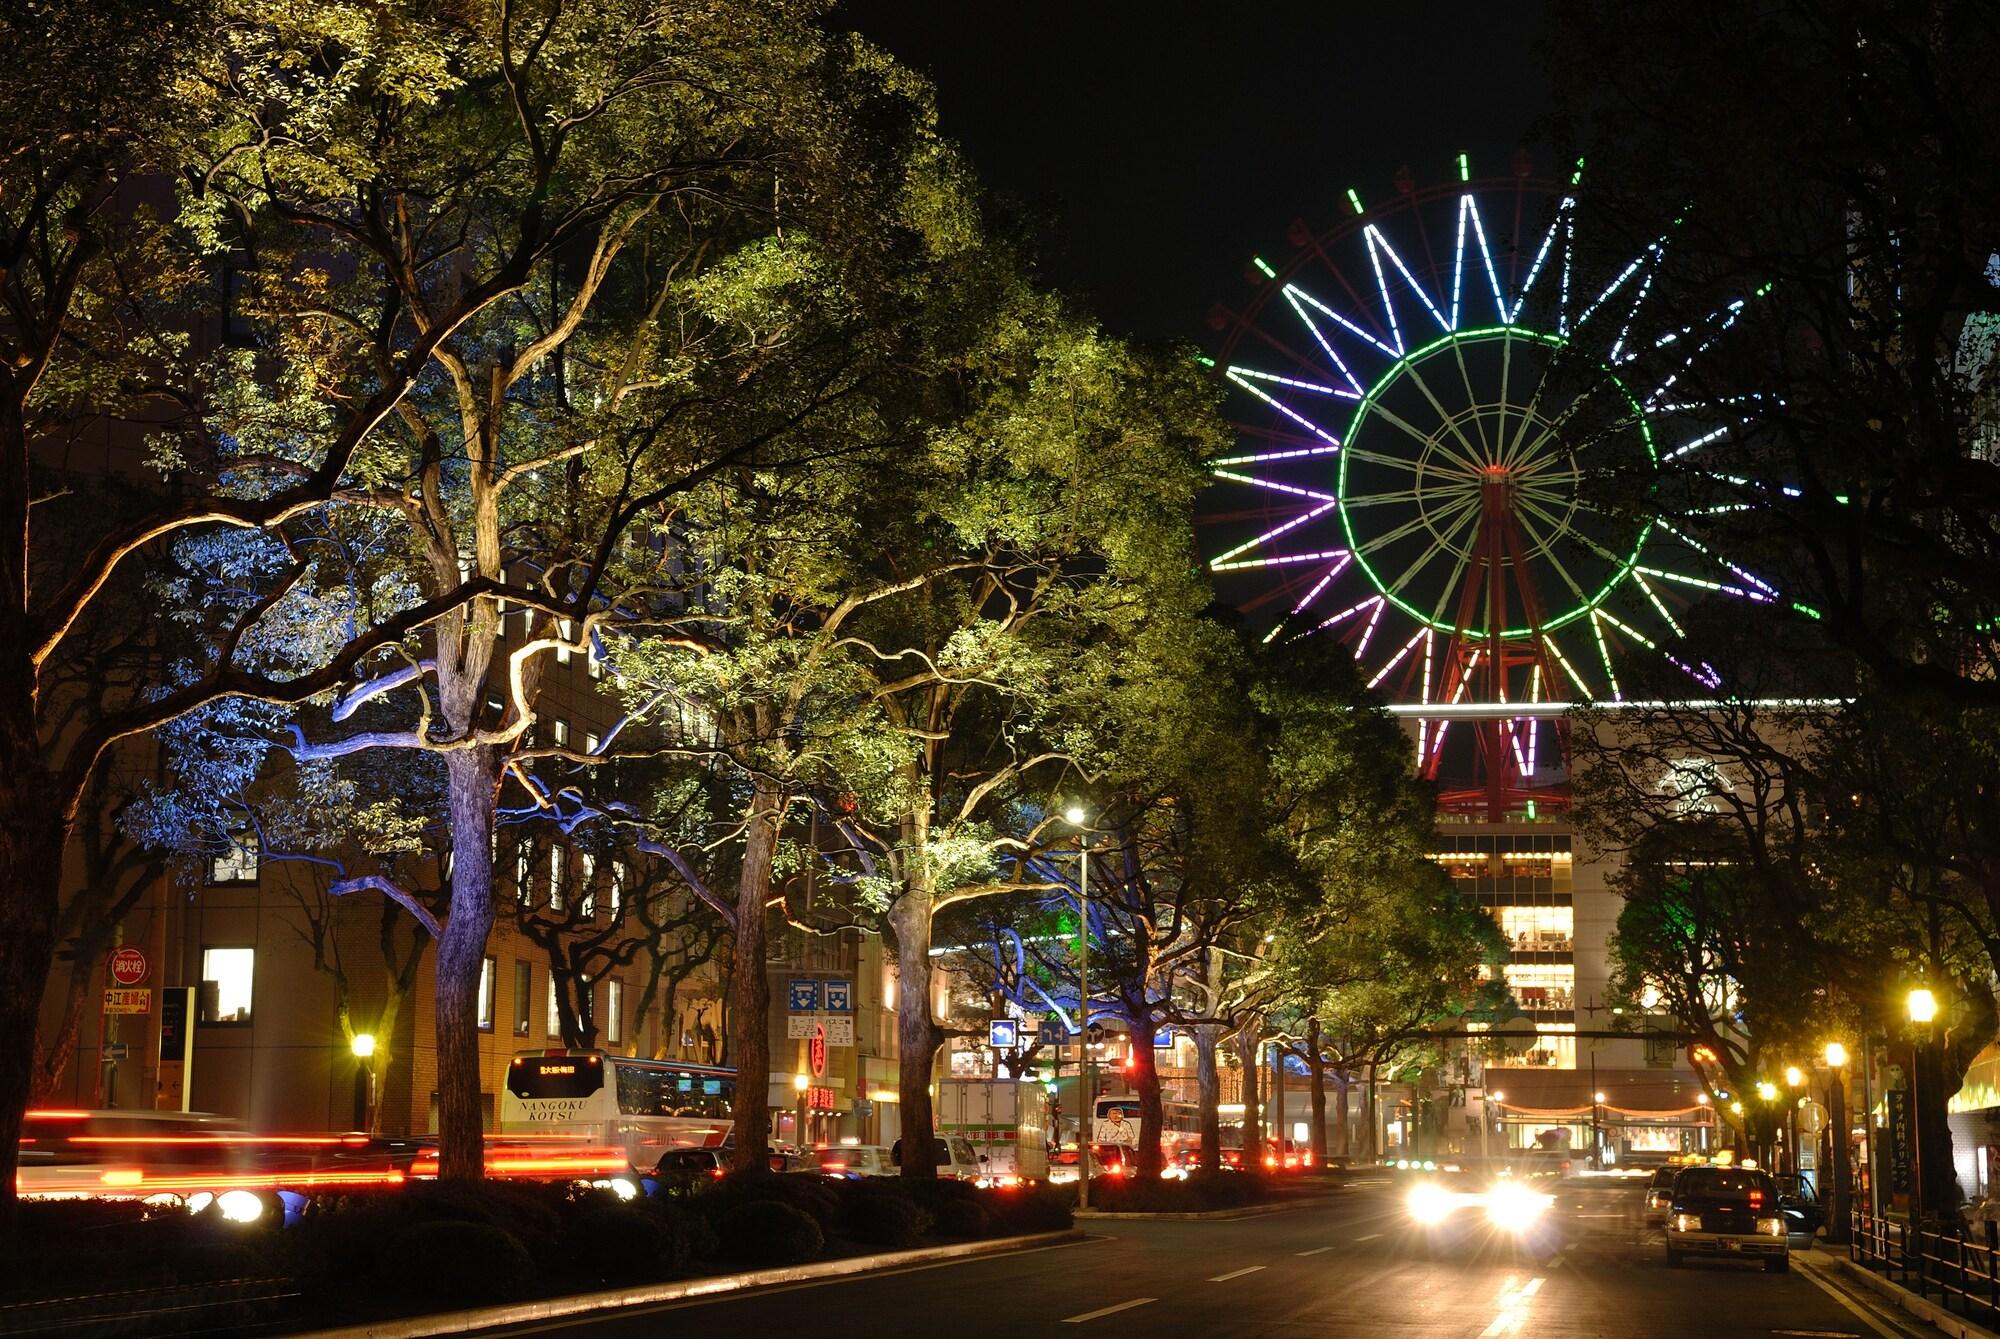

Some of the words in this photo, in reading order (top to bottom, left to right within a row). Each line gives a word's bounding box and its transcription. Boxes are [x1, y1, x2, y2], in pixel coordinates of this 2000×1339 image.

[115, 959, 143, 973] 消火栓
[520, 1101, 587, 1112] NANGOKU
[529, 1111, 576, 1121] KOTSU
